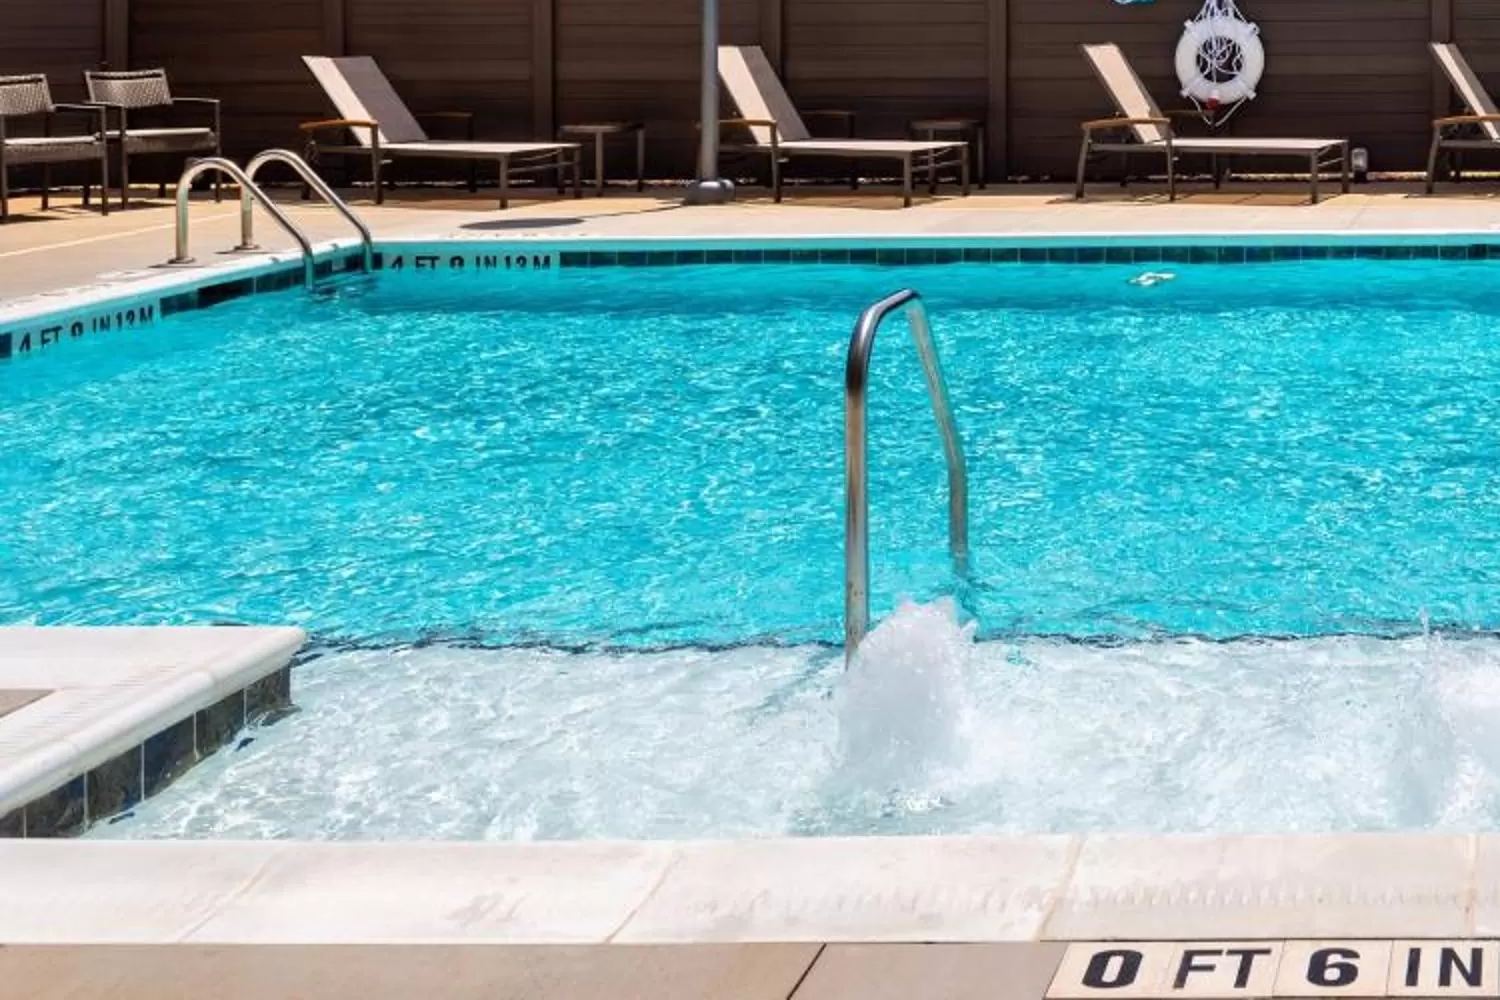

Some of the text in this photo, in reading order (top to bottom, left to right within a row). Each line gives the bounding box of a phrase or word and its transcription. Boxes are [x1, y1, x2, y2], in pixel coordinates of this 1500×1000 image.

[1082, 949, 1144, 989] 0
[1173, 948, 1272, 989] FT
[1306, 947, 1361, 988] 6
[1405, 947, 1484, 988] IN
